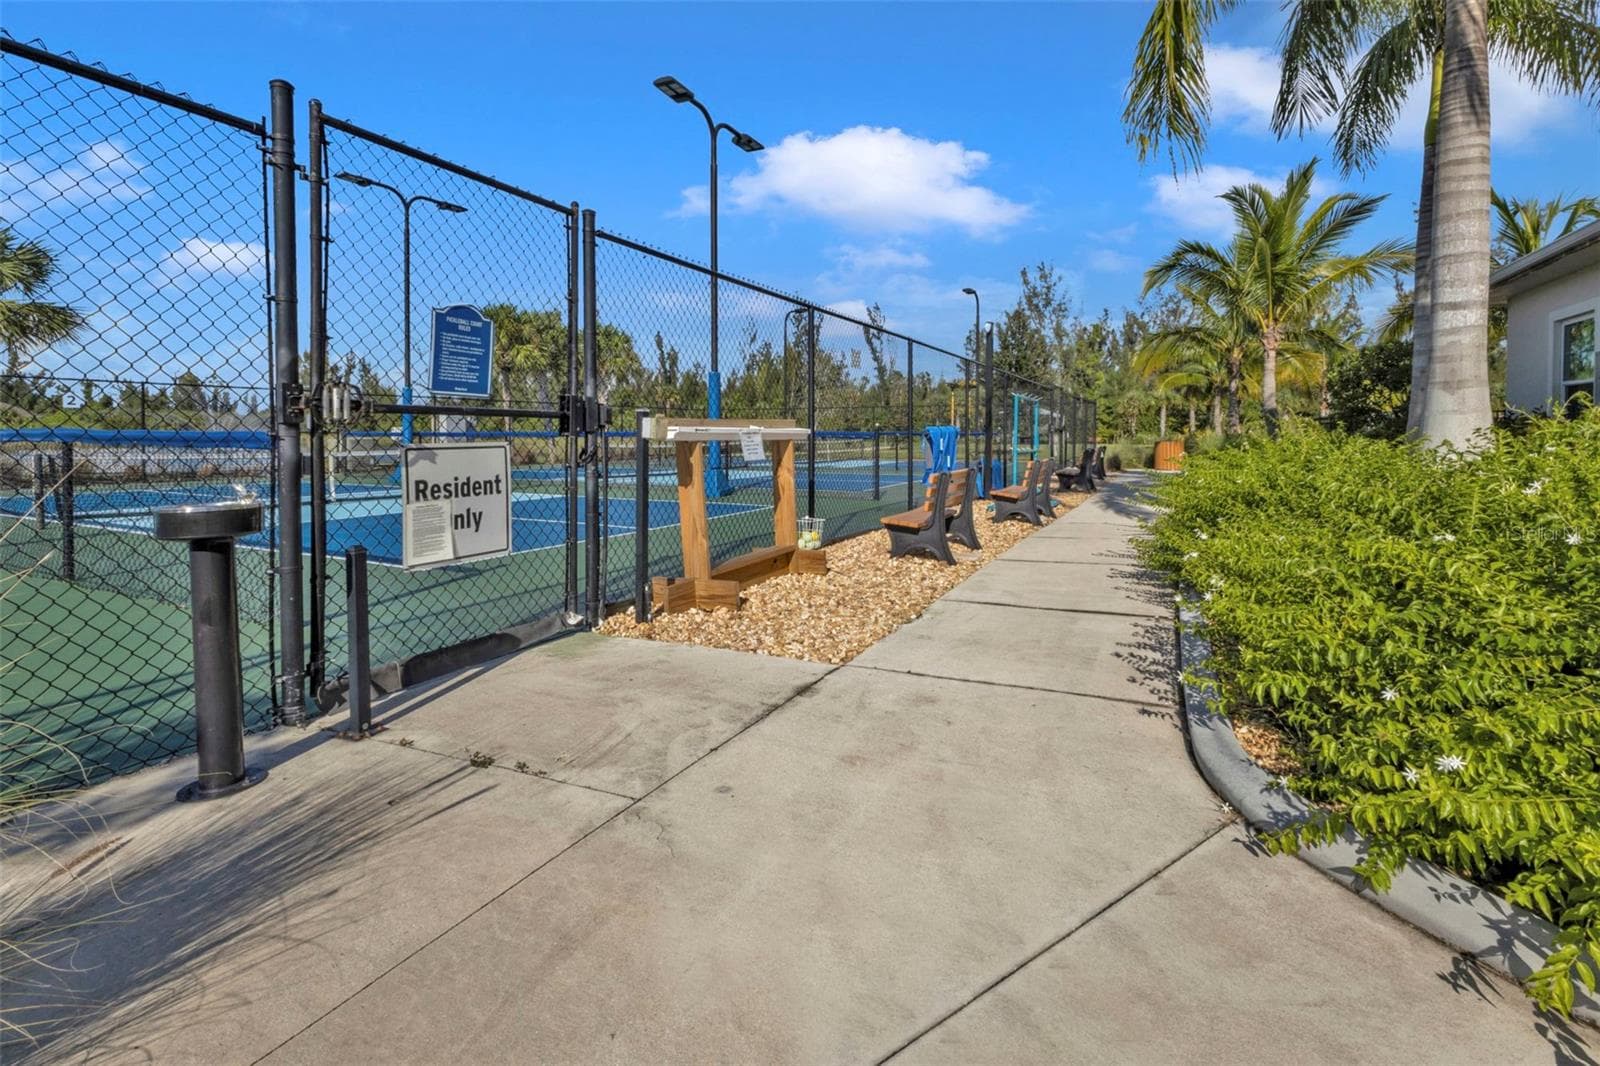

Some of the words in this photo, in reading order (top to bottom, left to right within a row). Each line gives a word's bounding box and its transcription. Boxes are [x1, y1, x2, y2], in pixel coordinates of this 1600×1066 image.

[458, 324, 471, 332] RULES
[67, 395, 76, 406] 2
[414, 474, 502, 502] Resident
[454, 508, 483, 533] nly
